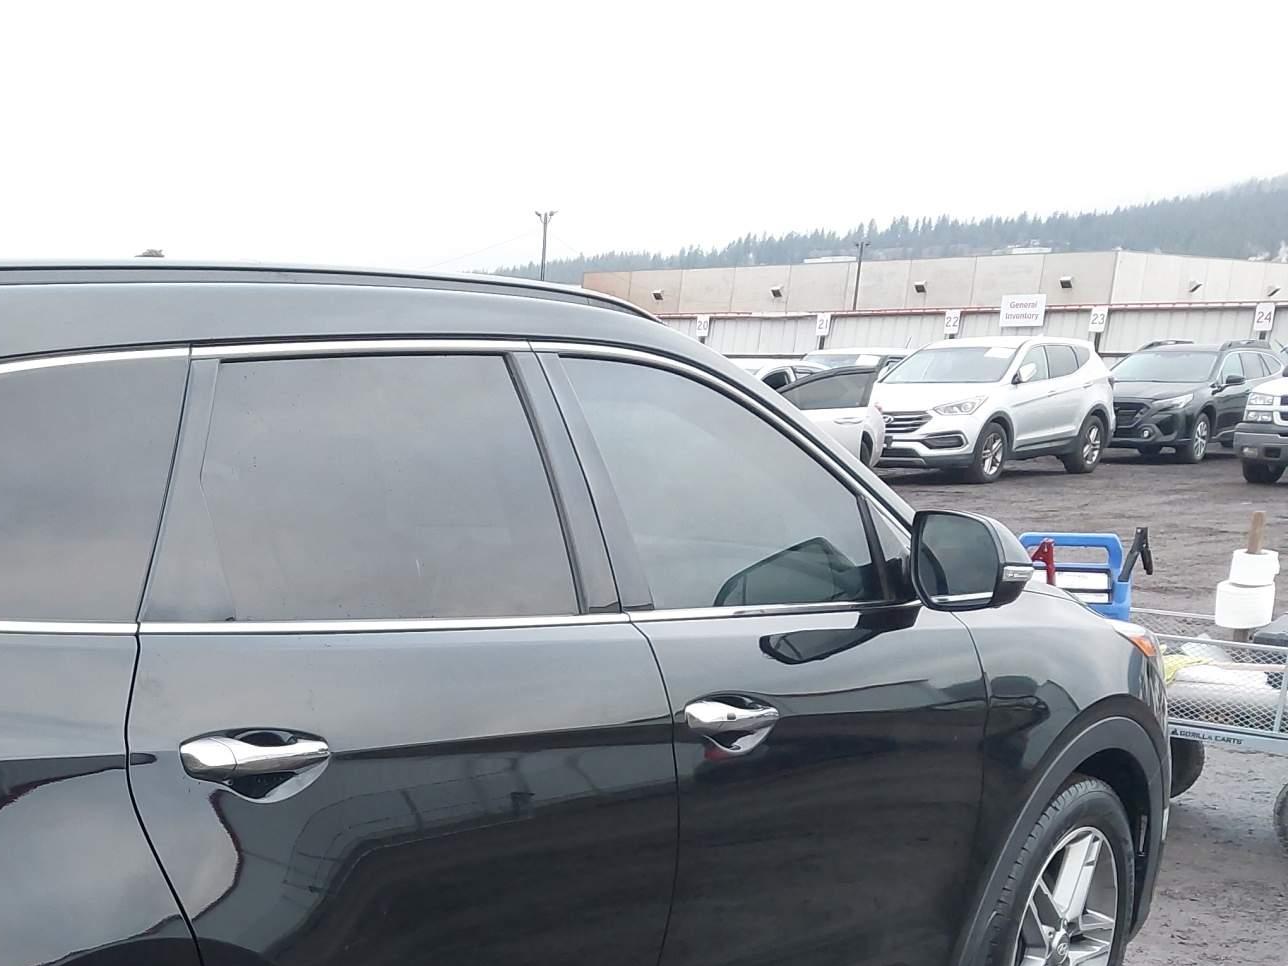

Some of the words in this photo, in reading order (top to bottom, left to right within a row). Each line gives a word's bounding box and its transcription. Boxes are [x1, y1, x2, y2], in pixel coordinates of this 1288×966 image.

[1009, 300, 1038, 309] General
[945, 316, 959, 328] 22
[1005, 312, 1040, 321] Inventory
[1091, 313, 1106, 325] 23
[1256, 311, 1272, 324] 24
[697, 320, 709, 331] 20
[818, 319, 829, 330] 21
